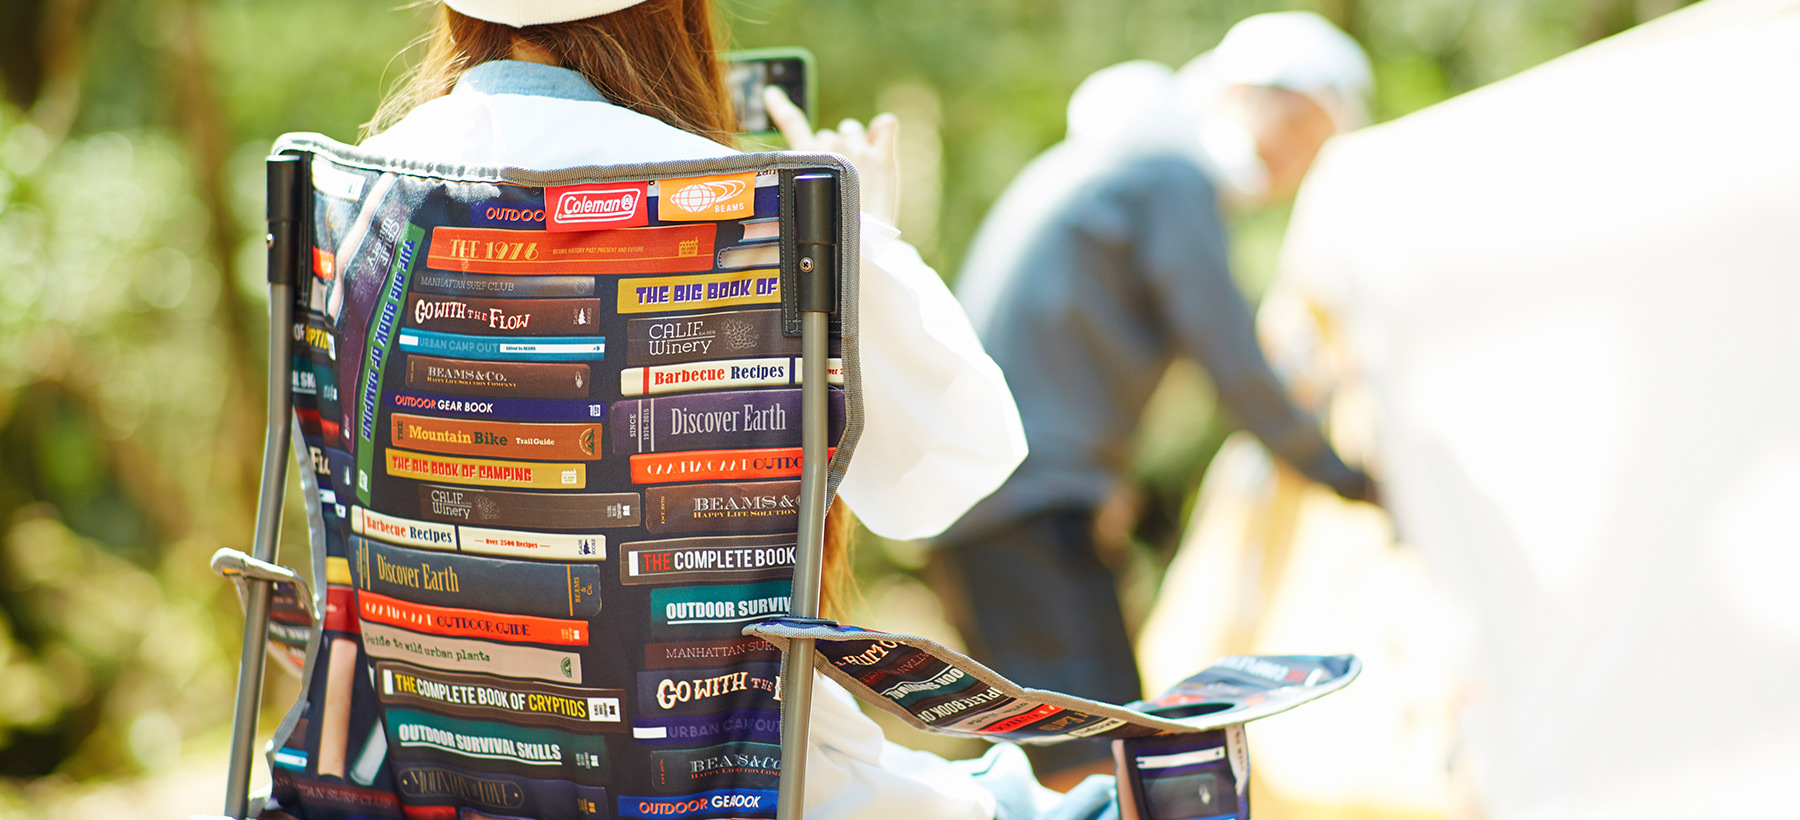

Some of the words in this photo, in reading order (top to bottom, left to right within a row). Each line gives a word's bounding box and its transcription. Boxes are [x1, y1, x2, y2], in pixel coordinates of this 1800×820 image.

[565, 196, 621, 215] Coleman
[714, 202, 745, 213] BEAMS
[397, 240, 416, 272] THE
[449, 239, 481, 259] THE
[485, 242, 539, 261] 1976
[389, 271, 406, 302] BIG
[420, 276, 467, 290] MANHATTAN
[467, 279, 487, 291] SURF
[487, 281, 515, 293] CLUB
[636, 286, 669, 305] THE
[673, 283, 702, 303] BIG
[707, 279, 752, 300] BOOK
[756, 277, 779, 296] OF
[373, 301, 398, 347] BOOK
[414, 299, 434, 325] GO
[433, 300, 467, 320] WITH
[467, 309, 488, 322] THE
[488, 307, 531, 330] FLOW
[649, 320, 704, 340] CALIF
[419, 338, 447, 351] URBAN
[449, 340, 475, 352] CAMP
[476, 341, 499, 353] OUT
[649, 339, 713, 357] Winery
[370, 346, 384, 370] OF
[427, 366, 508, 382] BEAMS&CO.
[654, 367, 725, 386] Barbecue
[730, 364, 785, 380] Recipes
[361, 368, 380, 442] CAMPING
[394, 394, 437, 410] OUTDOOR
[437, 399, 463, 411] GEAR
[464, 402, 494, 413] BOOK
[671, 407, 739, 436] Discover
[743, 403, 787, 432] Earth
[408, 424, 472, 444] Mountain
[474, 431, 508, 446] Bike
[516, 437, 533, 446] Trail
[533, 437, 555, 446] Guide
[392, 456, 411, 472] THE
[412, 459, 430, 475] BIG
[431, 461, 460, 478] BOOK
[461, 464, 477, 479] OF
[478, 465, 533, 483] CAMPING
[431, 489, 464, 505] CALIF
[432, 503, 471, 520] Winery
[693, 511, 724, 519] HAPPY
[726, 510, 750, 519] LIFE
[749, 509, 798, 518] SOLUTION
[366, 516, 406, 539] Barbecue
[409, 525, 452, 545] Recipes
[485, 538, 499, 546] Over
[500, 540, 515, 548] 2500
[515, 540, 538, 549] Recipes
[643, 553, 671, 571] THE
[674, 549, 753, 570] COMPLETE
[755, 546, 796, 568] BOOK
[376, 553, 420, 588] Discover
[422, 563, 460, 593] Earth
[666, 601, 735, 620] OUTDOOR
[436, 615, 495, 633] OUTDOOR
[496, 623, 531, 637] GUIDE
[393, 638, 404, 649] to
[404, 640, 424, 655] wild
[424, 642, 454, 659] urban
[455, 649, 491, 663] plants
[666, 644, 746, 659] MANHATTAN
[394, 673, 417, 694] THE
[416, 678, 477, 704] COMPLETE
[477, 688, 510, 709] BOOK
[509, 692, 526, 711] OF
[528, 694, 587, 719] CRYPTIDS
[656, 678, 691, 710] GO
[692, 671, 748, 701] WITH
[751, 677, 774, 693] THE
[398, 723, 455, 748] OUTDOOR
[455, 733, 517, 757] SURVIVAL
[516, 742, 562, 760] SKILLS
[669, 723, 719, 739] URBAN
[639, 797, 708, 815] OUTDOOR
